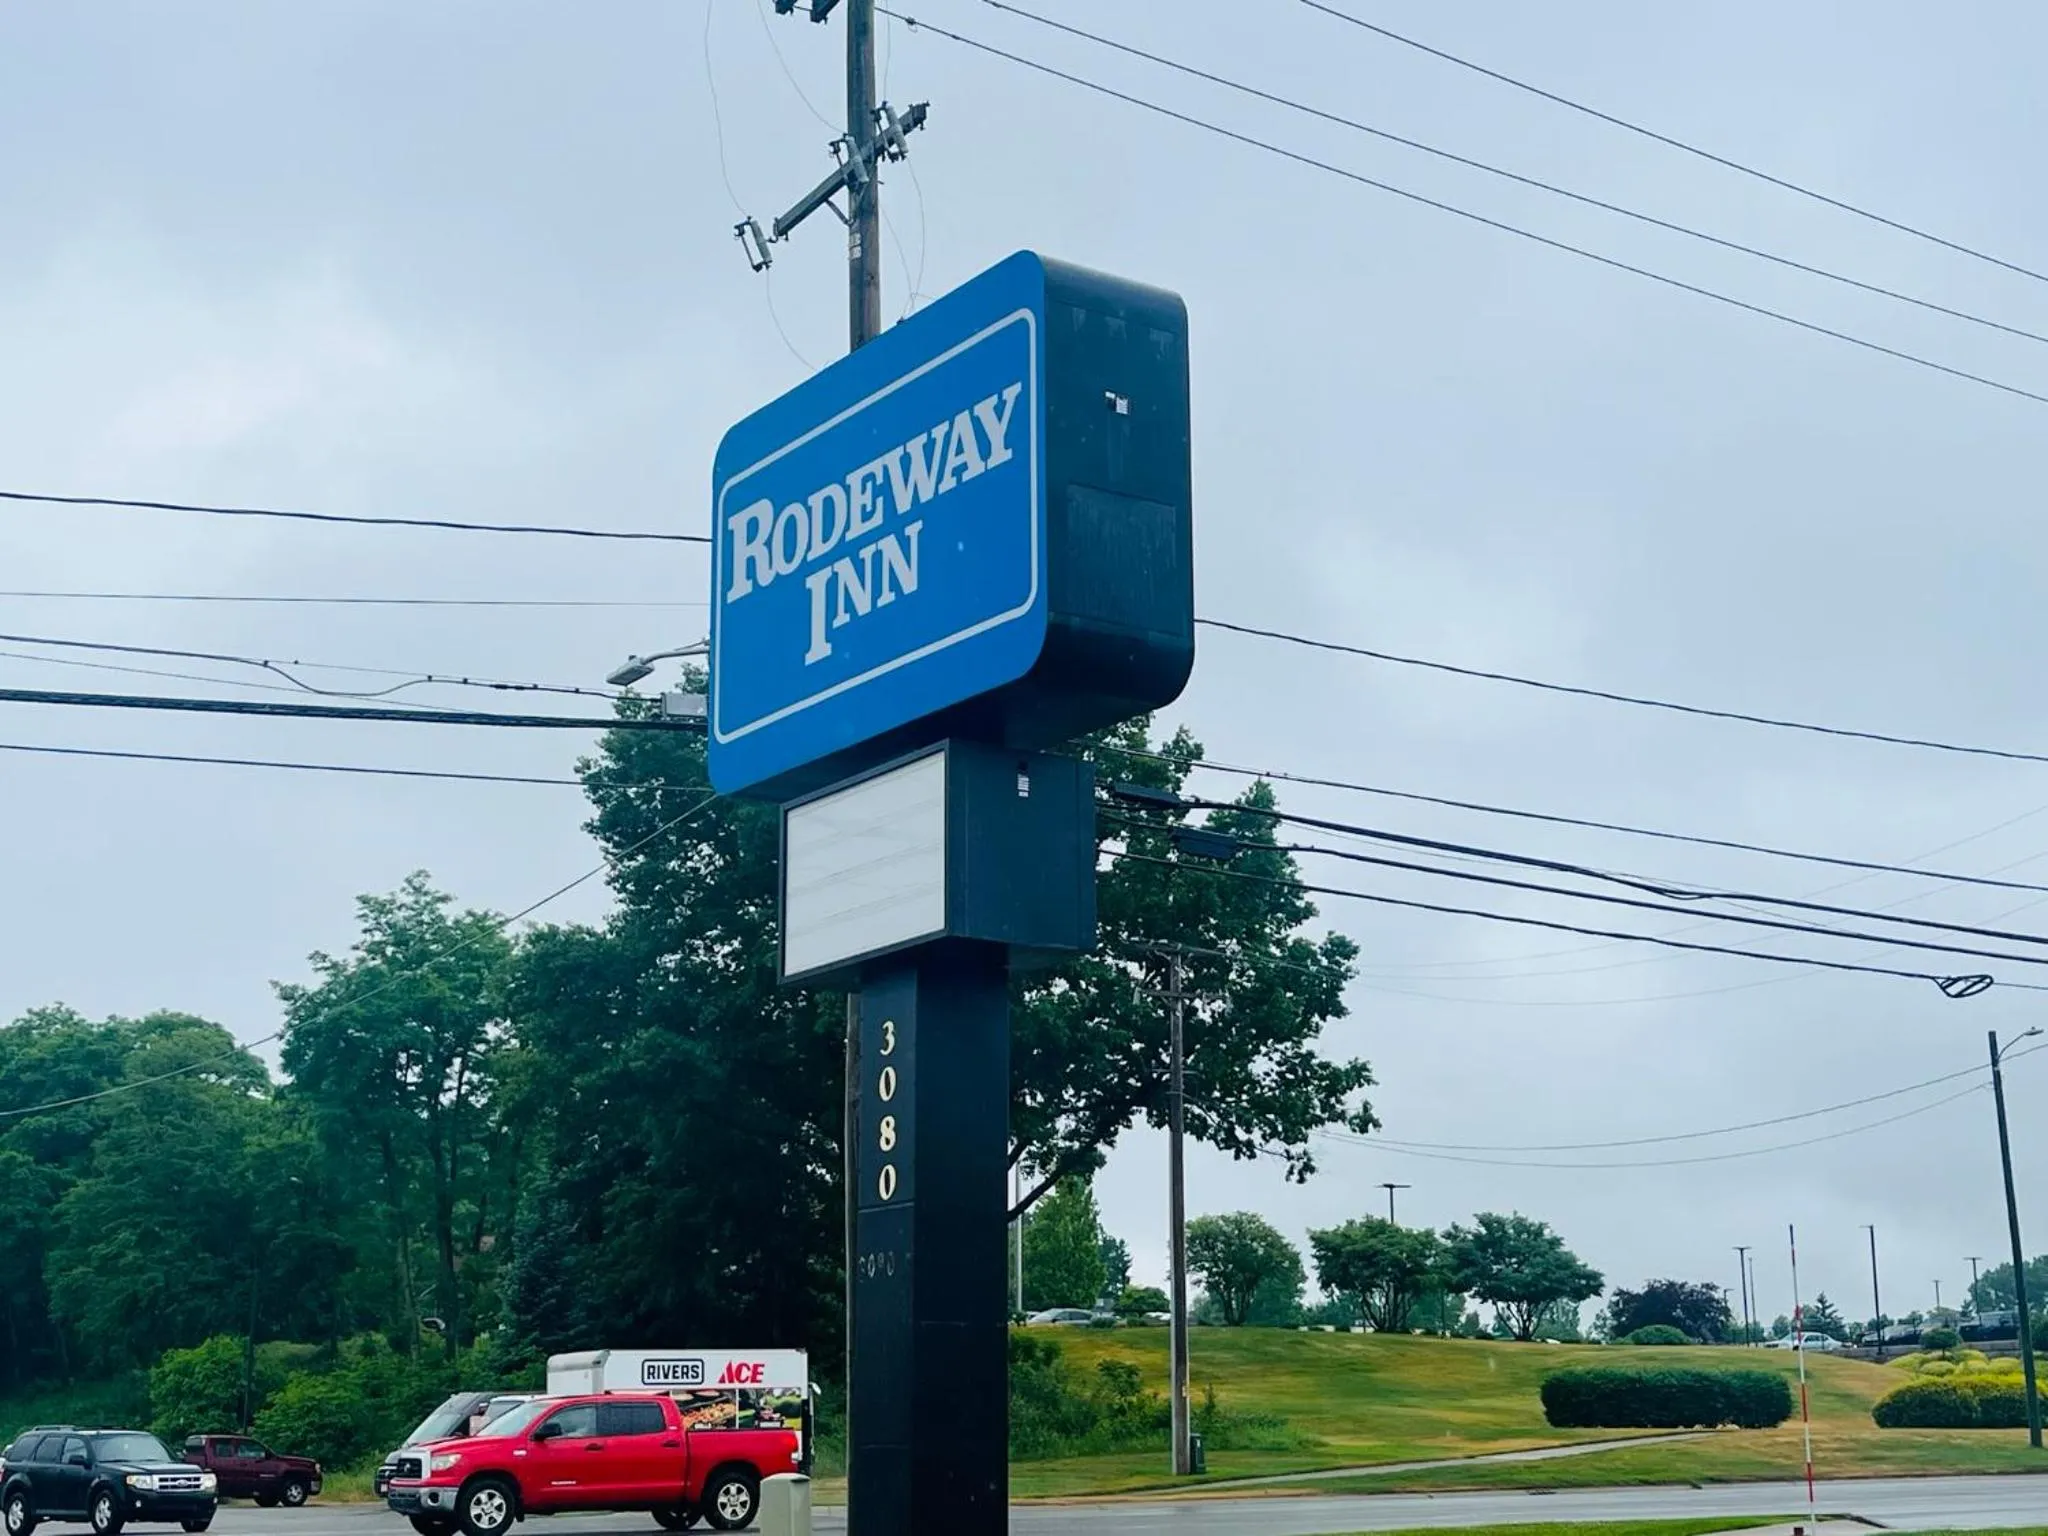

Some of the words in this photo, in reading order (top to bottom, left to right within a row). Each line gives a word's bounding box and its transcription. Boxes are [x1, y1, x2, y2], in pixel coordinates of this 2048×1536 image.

[727, 382, 1022, 604] RODEWAY
[804, 520, 923, 666] INN
[879, 1020, 897, 1201] 3080
[646, 1364, 700, 1380] RIVERS
[718, 1361, 765, 1384] ACE
